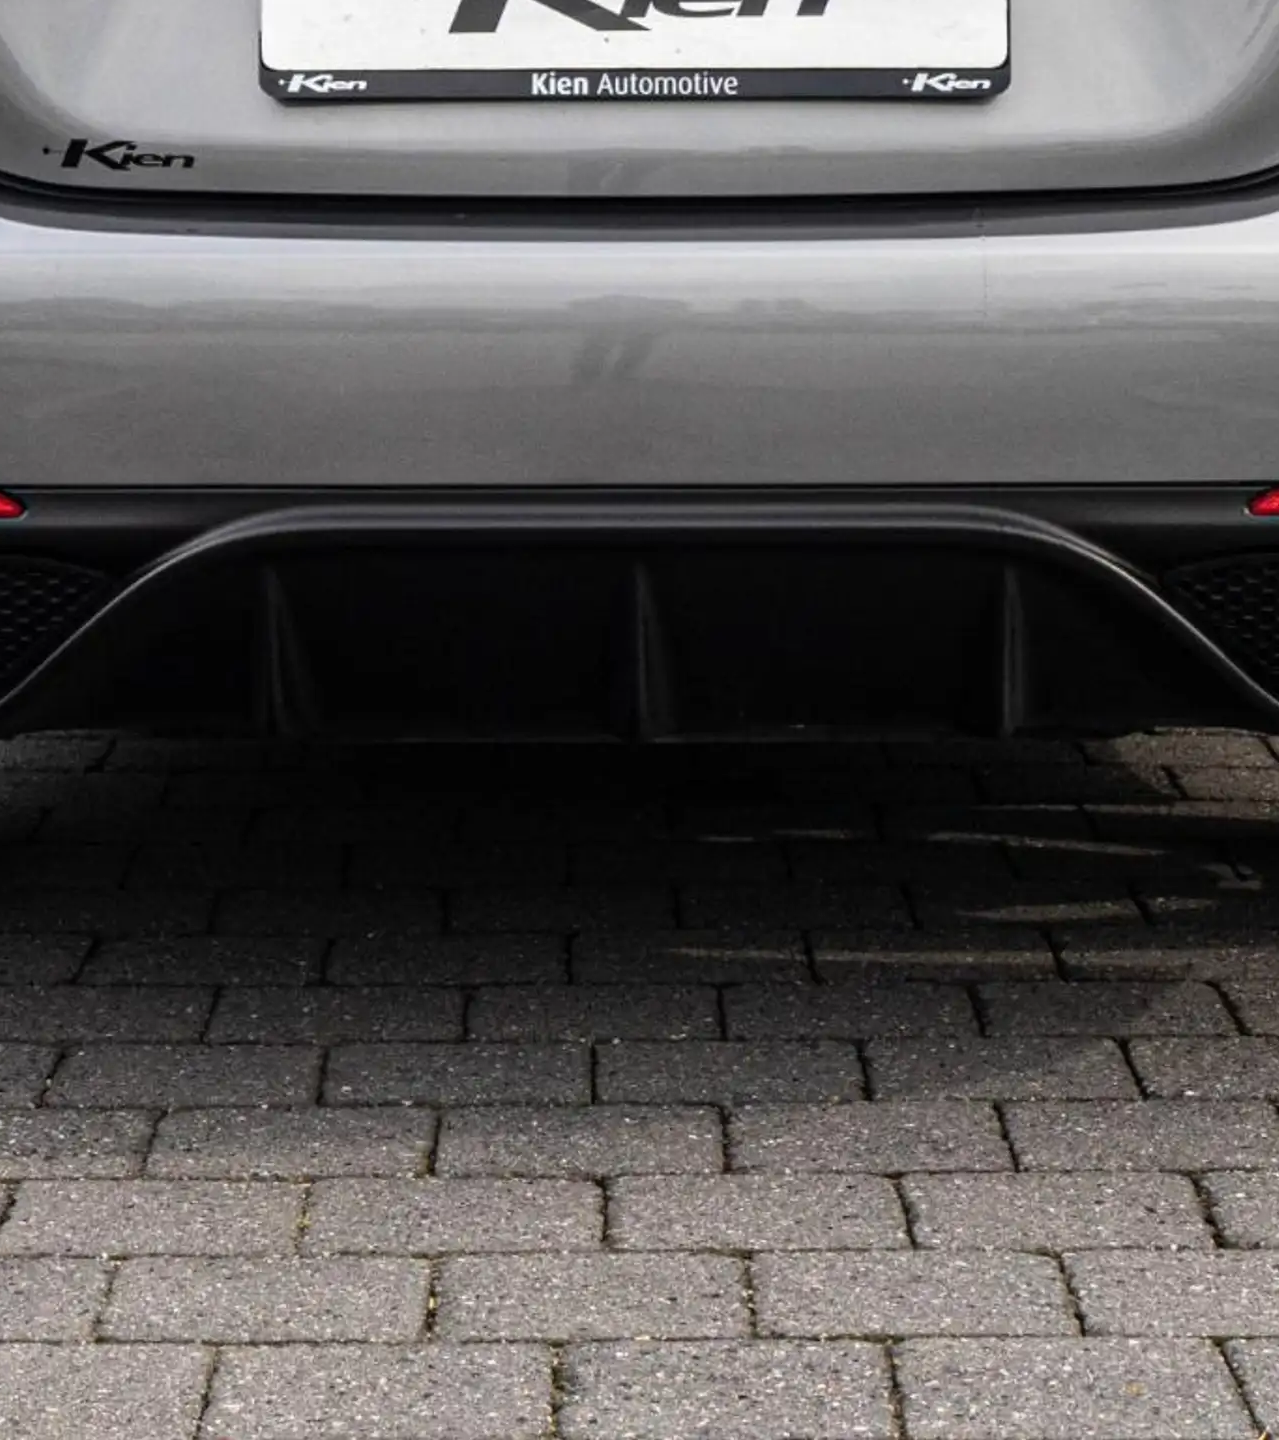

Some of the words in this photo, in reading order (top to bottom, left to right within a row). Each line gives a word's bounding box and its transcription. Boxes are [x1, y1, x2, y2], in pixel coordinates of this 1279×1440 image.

[286, 73, 369, 94] Kien
[530, 71, 590, 96] Kien
[596, 70, 740, 96] Automotive
[910, 72, 992, 93] Kien
[60, 138, 197, 172] Kien
